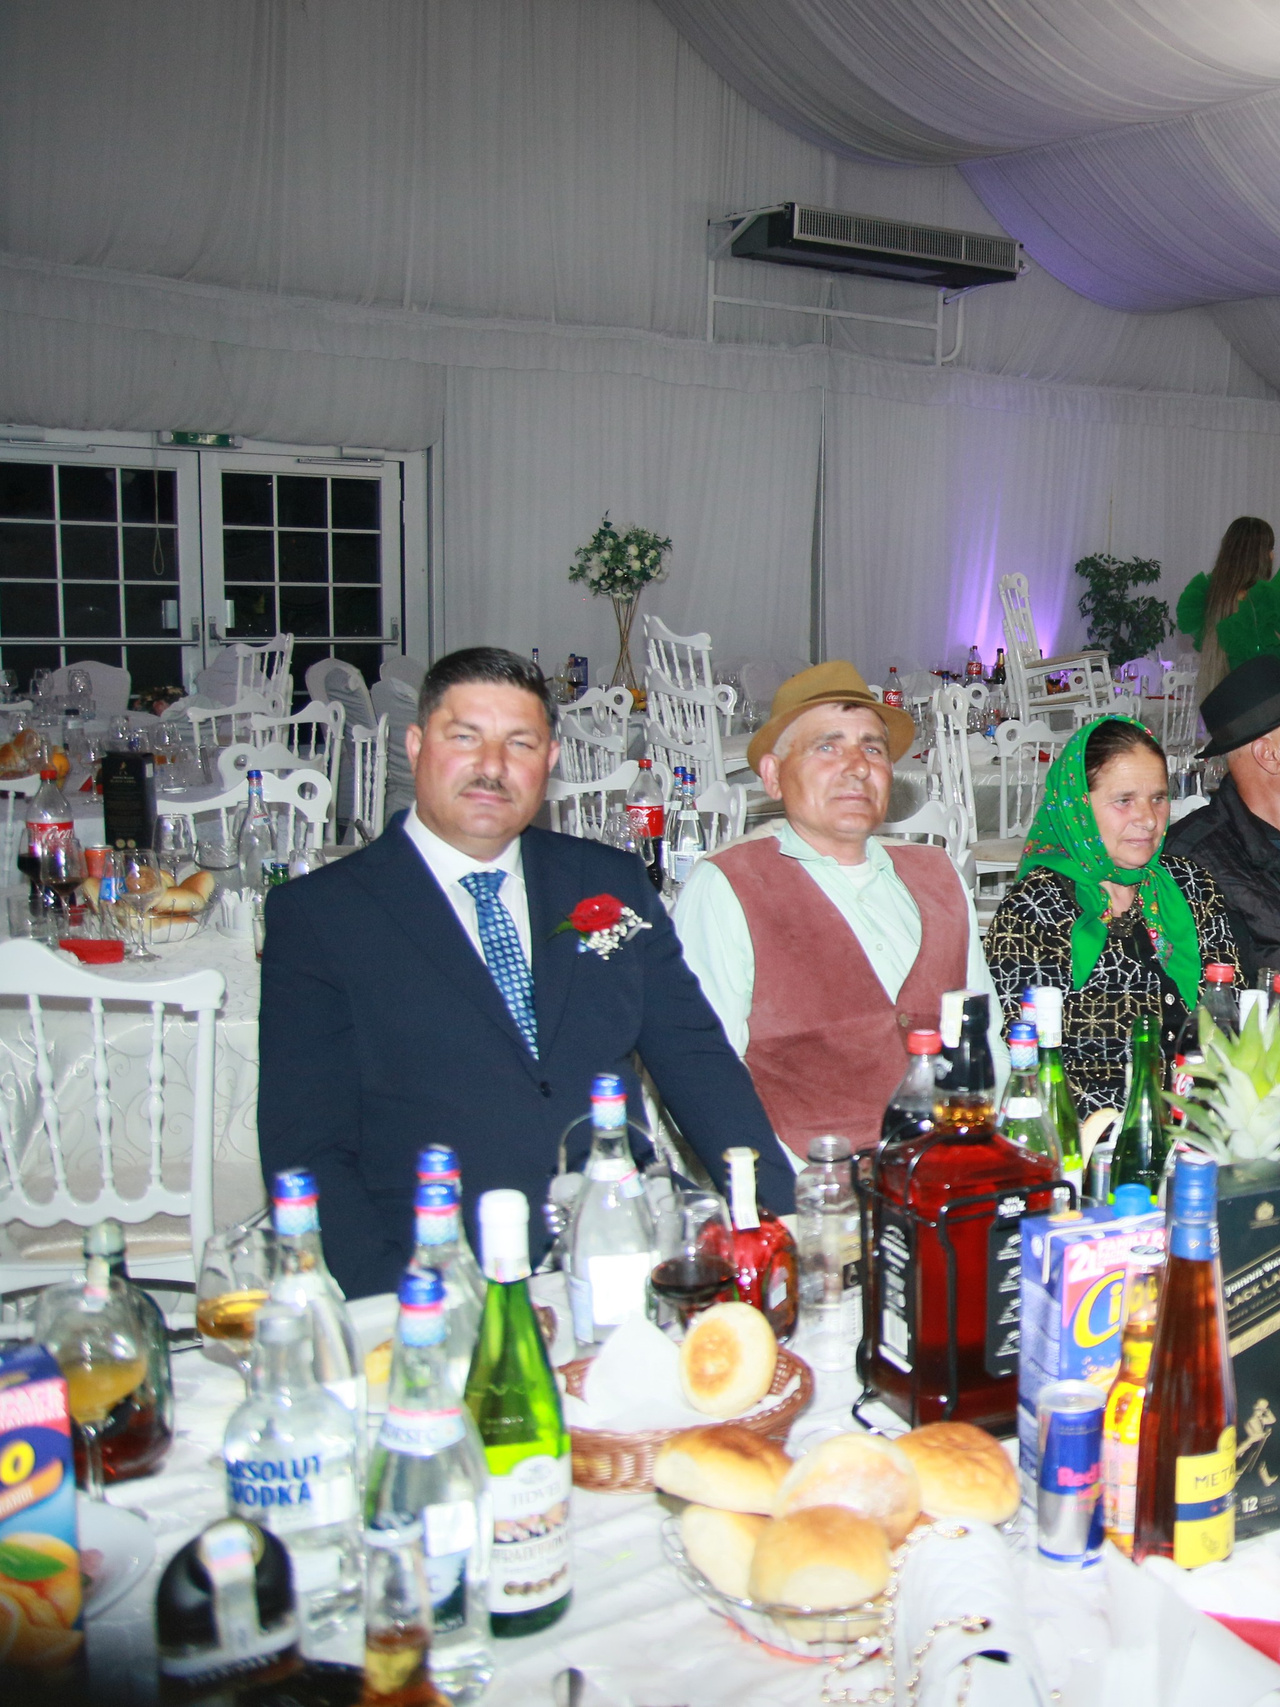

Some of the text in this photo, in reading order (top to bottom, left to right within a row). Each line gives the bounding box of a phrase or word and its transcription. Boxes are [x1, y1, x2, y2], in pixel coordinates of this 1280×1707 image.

[1068, 1244, 1105, 1283] 2L
[1224, 1267, 1265, 1298] JOHNNIE
[1073, 1269, 1126, 1349] Ci
[1226, 1283, 1262, 1311] LACK
[226, 1454, 321, 1482] ABSOLUT
[1057, 1461, 1105, 1488] Red
[1195, 1464, 1236, 1490] META
[229, 1481, 312, 1508] VODKA
[511, 1481, 562, 1506] JIDVE
[1241, 1496, 1259, 1514] 12
